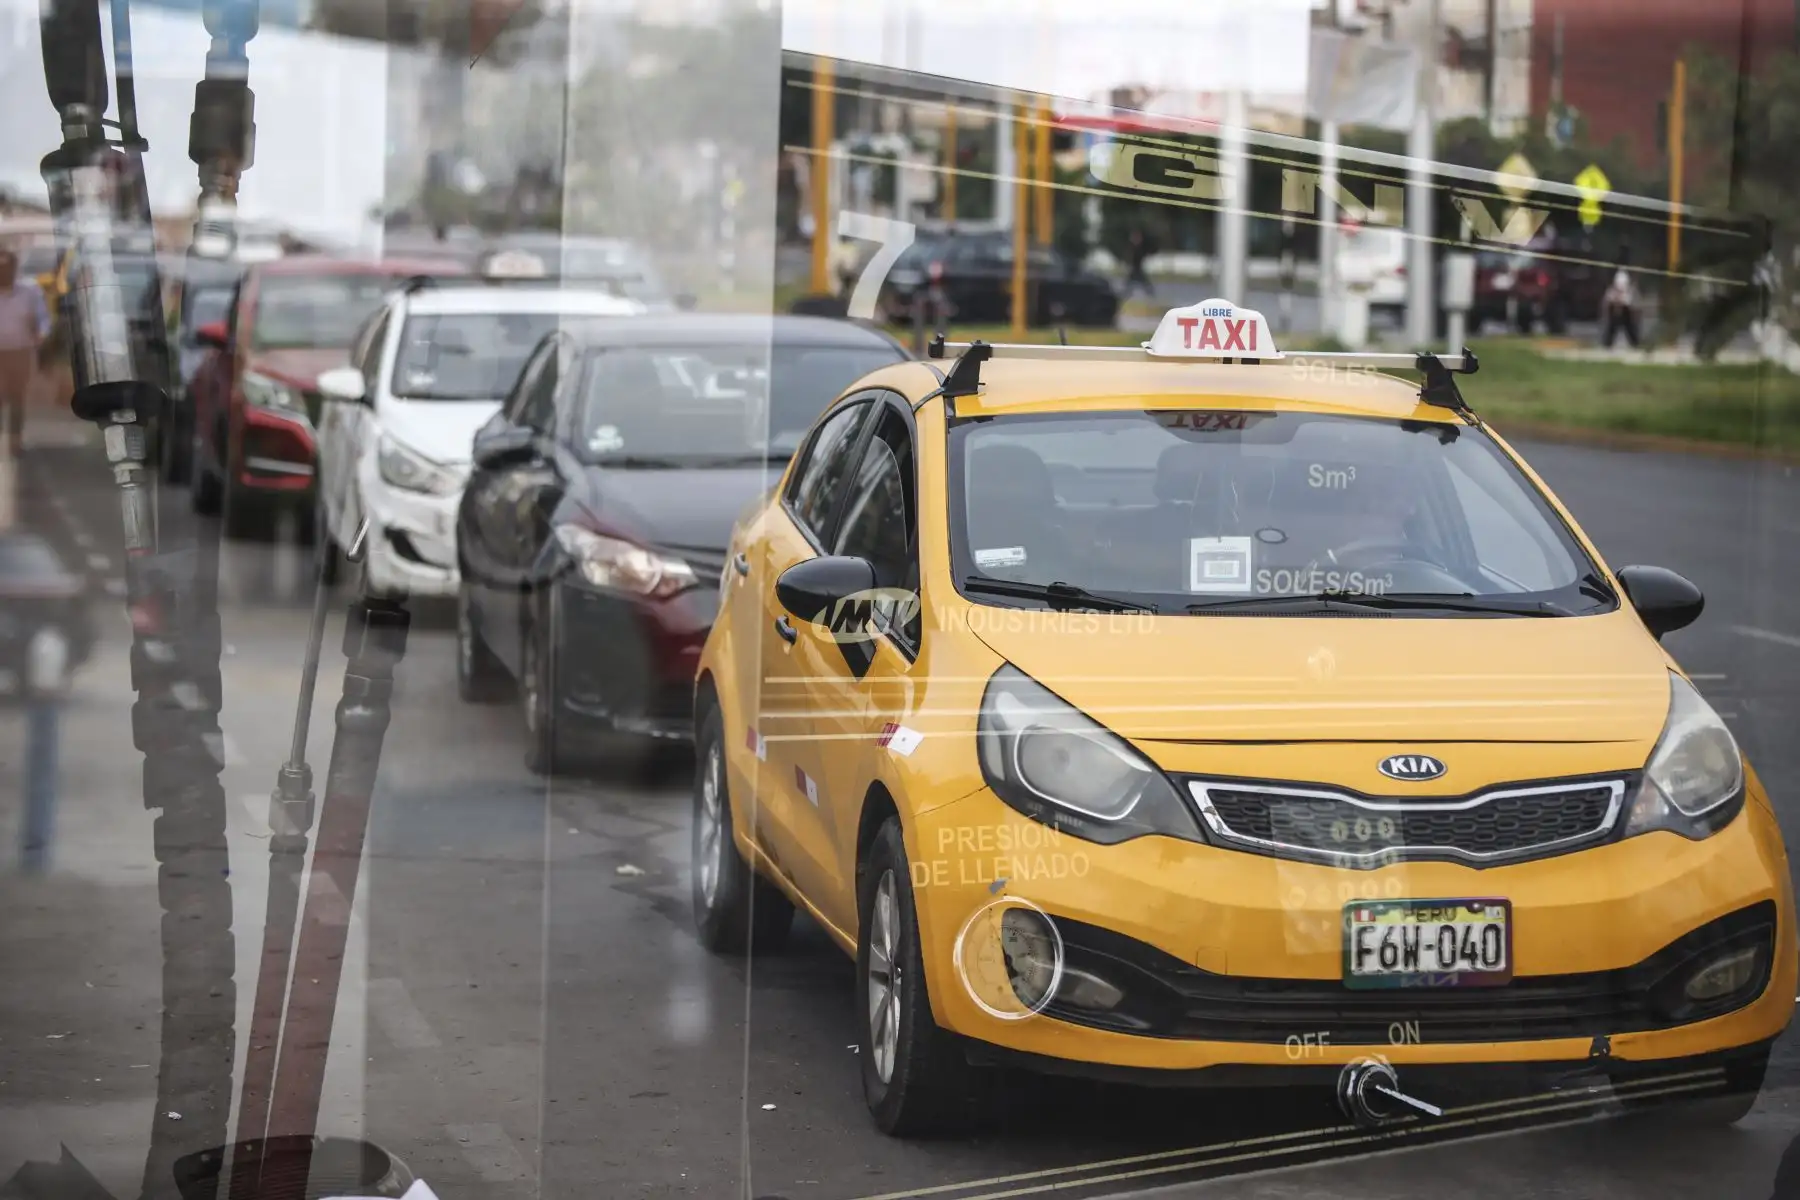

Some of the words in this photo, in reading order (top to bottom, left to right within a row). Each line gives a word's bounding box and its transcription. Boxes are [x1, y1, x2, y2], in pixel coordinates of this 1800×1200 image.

[838, 209, 916, 319] 7
[1202, 307, 1233, 318] LIBRE
[1177, 317, 1258, 352] TAXI
[1292, 356, 1379, 387] SOLES
[939, 604, 1100, 635] INDUSTRIES
[1388, 756, 1439, 774] KIA
[911, 859, 951, 889] DE
[959, 851, 1091, 885] LLENADO
[1356, 923, 1501, 971] F6W-040
[1285, 1031, 1331, 1061] OFF
[1388, 1020, 1422, 1047] ON
